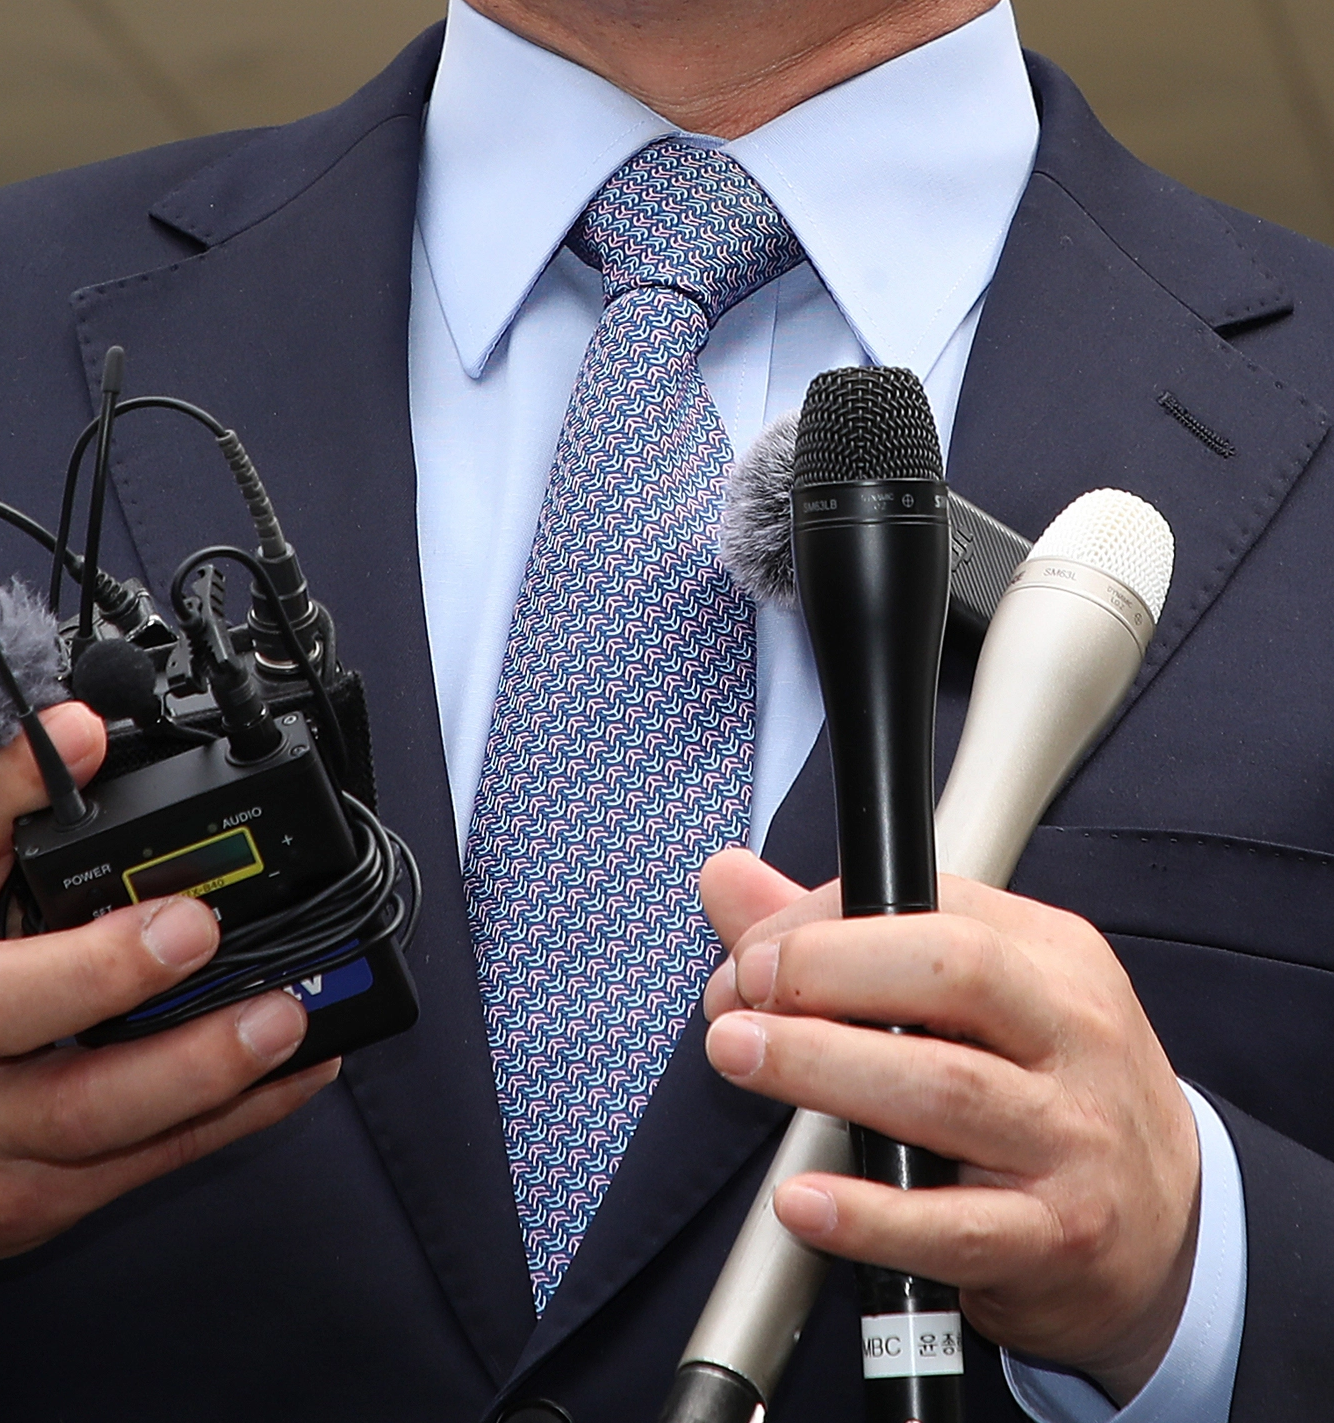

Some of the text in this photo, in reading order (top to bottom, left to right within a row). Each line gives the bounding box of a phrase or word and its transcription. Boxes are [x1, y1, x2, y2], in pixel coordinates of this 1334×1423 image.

[803, 499, 837, 513] SM63LB
[1043, 568, 1076, 581] SM63L
[223, 807, 262, 829] AUDIO
[63, 863, 112, 889] POWER
[181, 878, 225, 898] TX-B40
[862, 1336, 901, 1357] MBC
